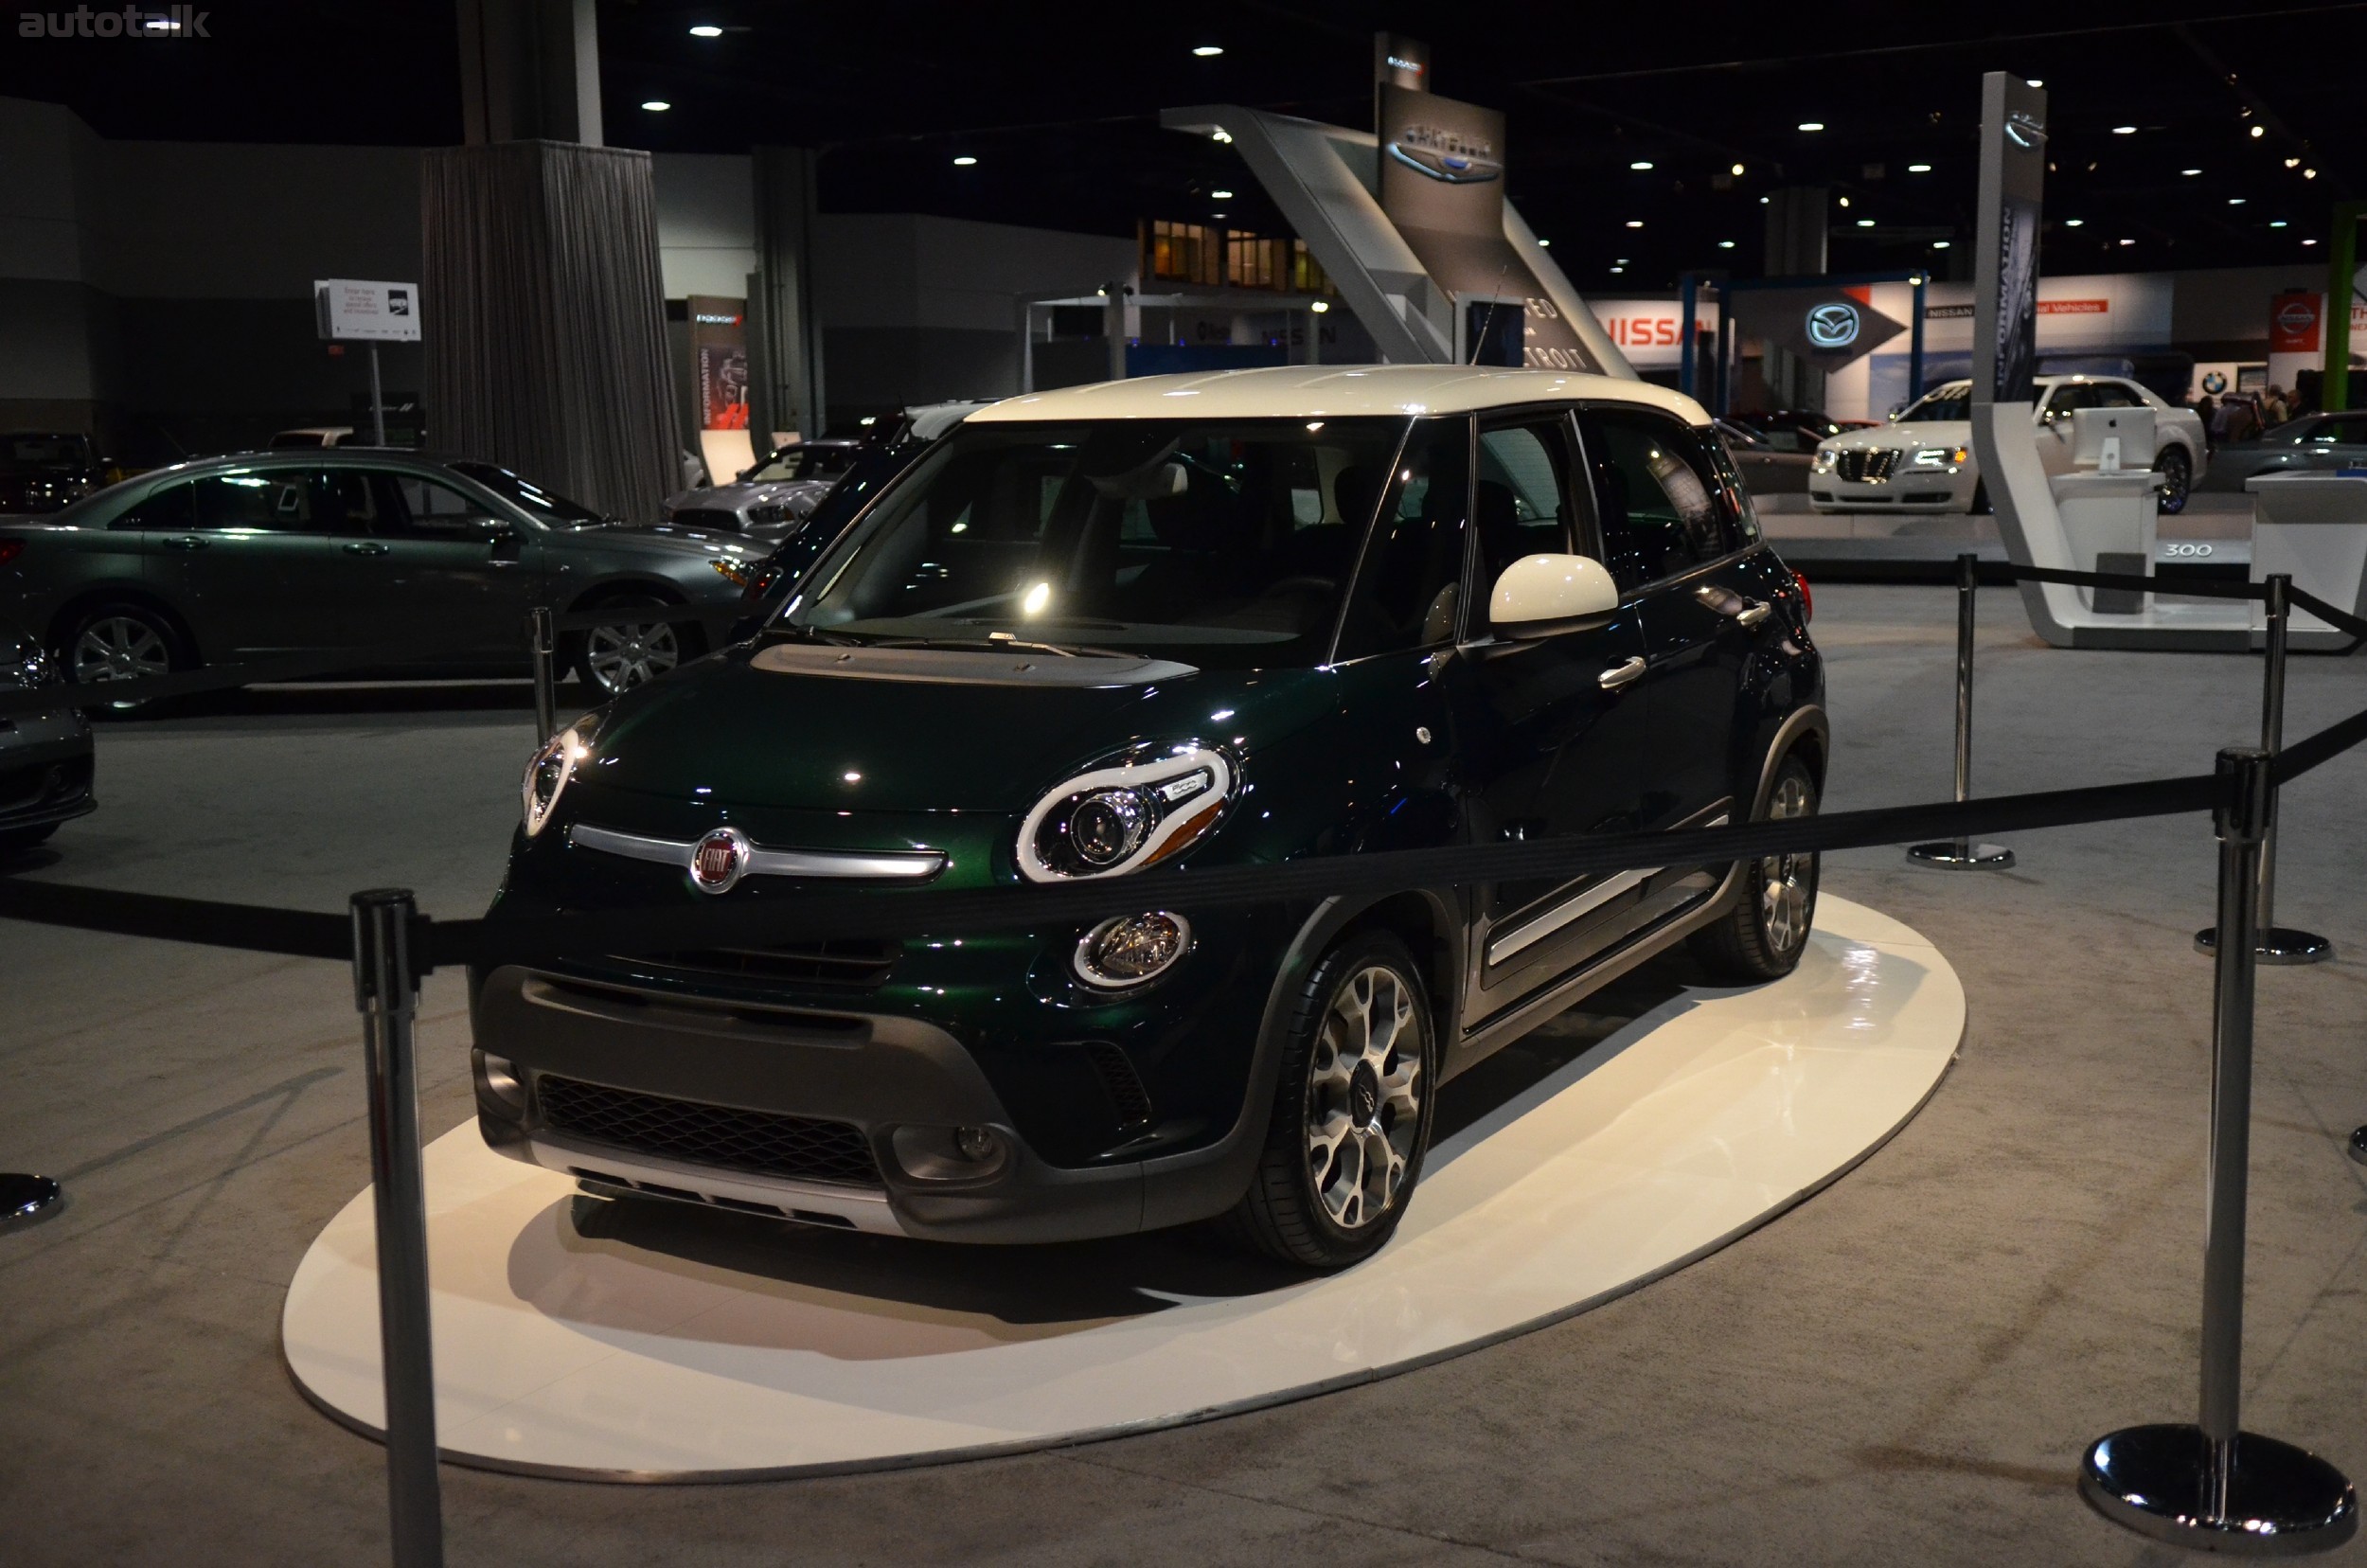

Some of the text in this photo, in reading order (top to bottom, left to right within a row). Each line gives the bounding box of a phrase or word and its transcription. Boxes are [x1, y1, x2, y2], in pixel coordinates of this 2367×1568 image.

[1997, 206, 2012, 386] INFORMATION
[1928, 308, 1974, 318] NISSAN
[2051, 300, 2101, 313] Vehicles
[1596, 318, 1712, 347] NISS
[1522, 347, 1588, 370] TROIT
[701, 347, 711, 425] INFORMATION
[2164, 543, 2213, 558] 300
[703, 847, 731, 872] FIAT
